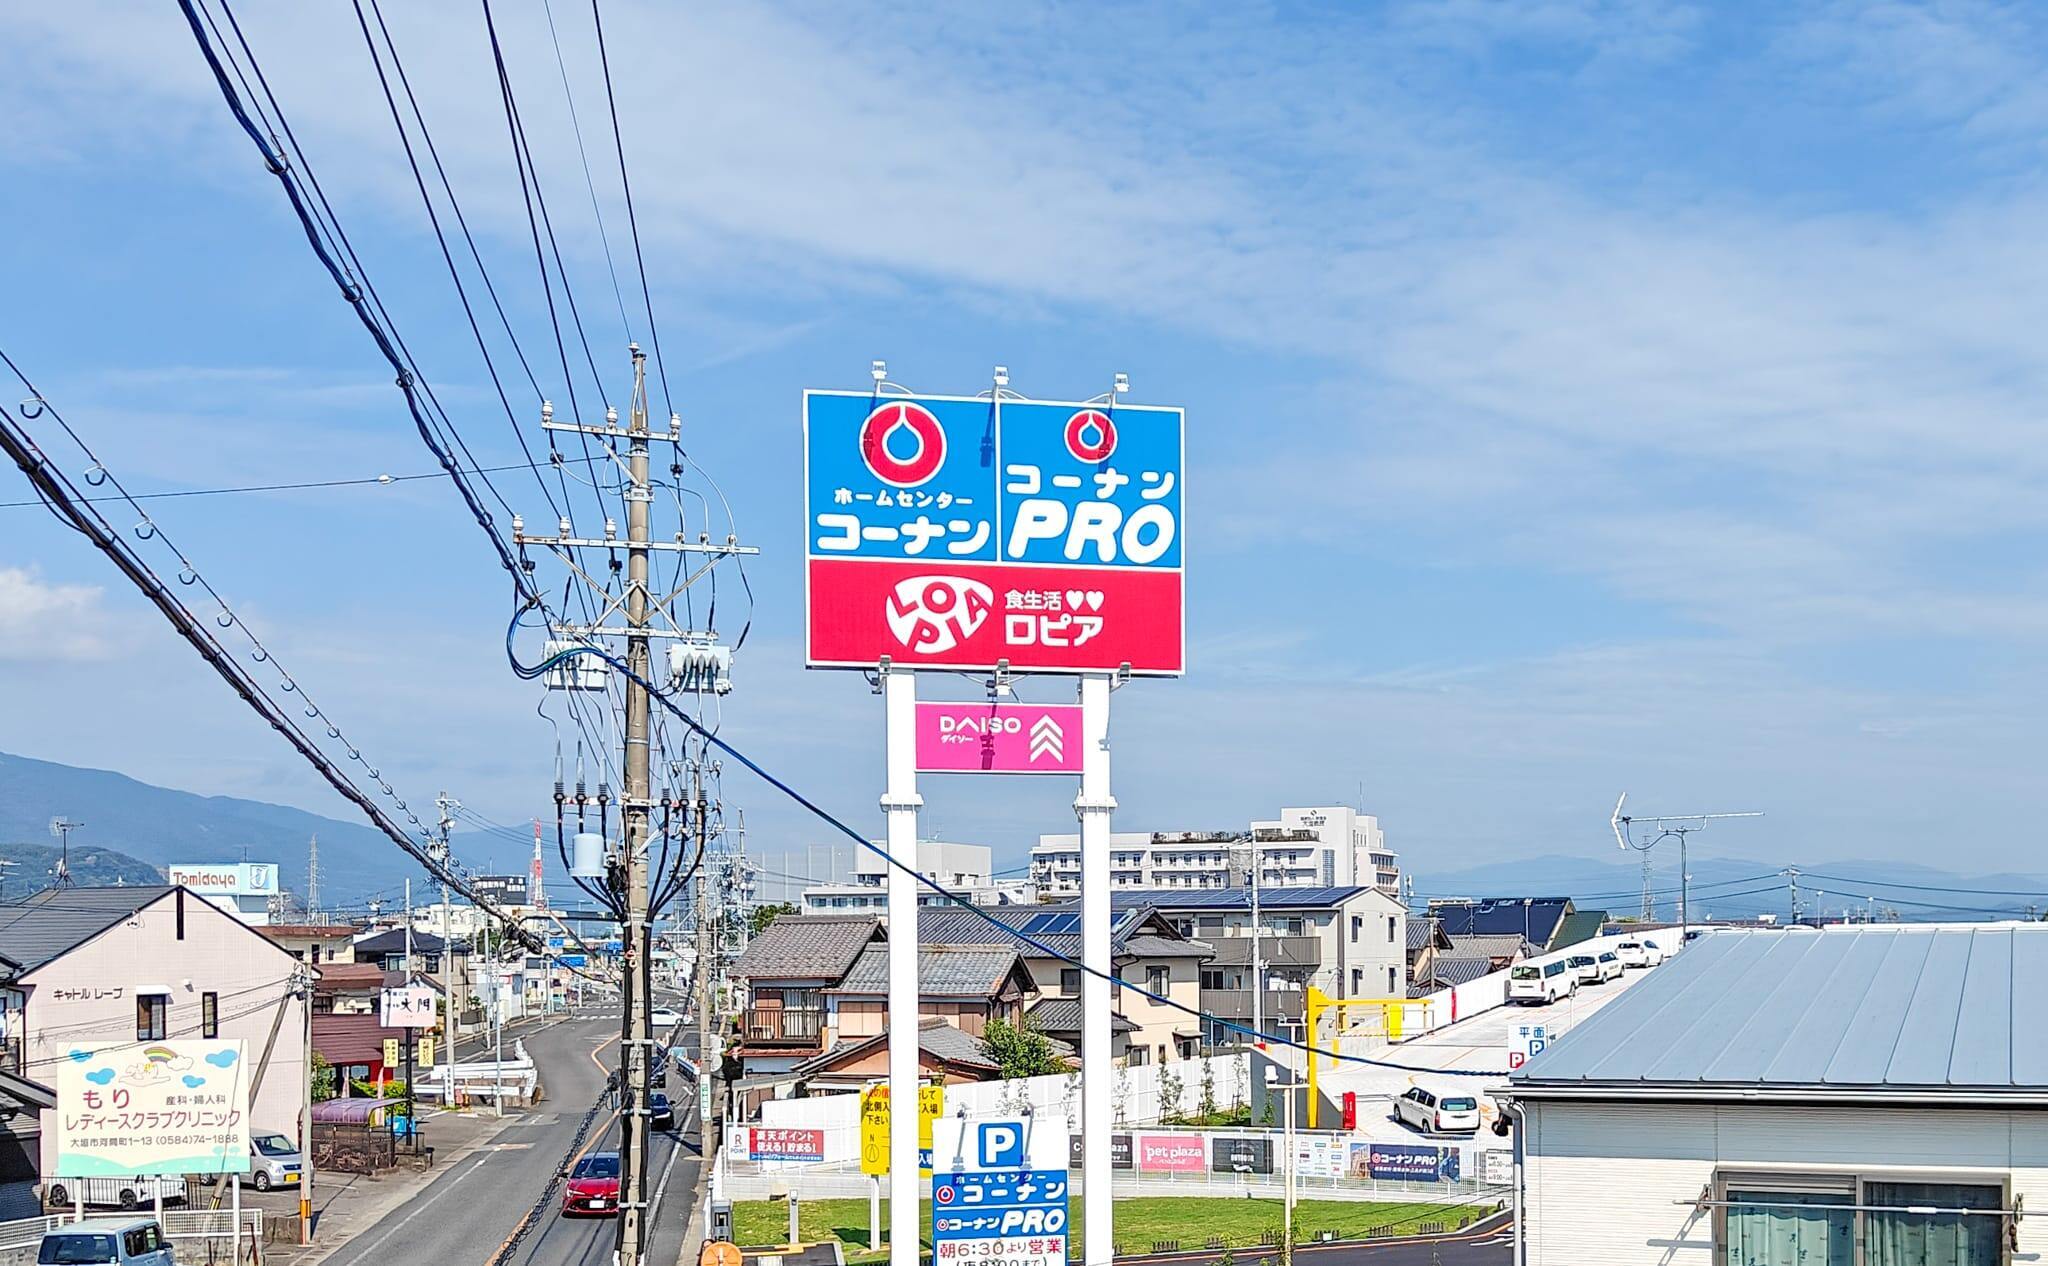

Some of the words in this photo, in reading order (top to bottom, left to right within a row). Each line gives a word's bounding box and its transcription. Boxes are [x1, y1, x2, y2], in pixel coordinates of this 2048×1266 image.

[1006, 464, 1175, 499] コーナン
[834, 487, 973, 510] ホームセンター
[817, 513, 990, 555] コーナン
[1007, 499, 1176, 564] PRO
[1004, 590, 1062, 611] 食生活
[1004, 614, 1104, 647] ロピア
[939, 716, 1022, 734] DAISO
[940, 734, 974, 744] ダイソー
[173, 872, 236, 888] Tomidaya
[53, 987, 91, 1000] キャトル
[1519, 1026, 1545, 1038] 平面
[1531, 1041, 1542, 1056] P
[1511, 1053, 1523, 1067] P
[83, 1089, 130, 1110] もり
[166, 1094, 226, 1106] 産科・婦人科
[66, 1110, 241, 1130] レディースクラブクリニック
[756, 1130, 814, 1141] 楽天ポイント
[985, 1127, 1016, 1163] P
[1145, 1146, 1168, 1161] pet
[1169, 1145, 1202, 1159] plaza
[1381, 1154, 1413, 1164] コーナン
[1414, 1155, 1437, 1166] PRO
[955, 1174, 1047, 1184] ホームセンター
[962, 1183, 1066, 1203] コーナン
[948, 1217, 1000, 1231] コーナン
[1000, 1209, 1066, 1235] PRO
